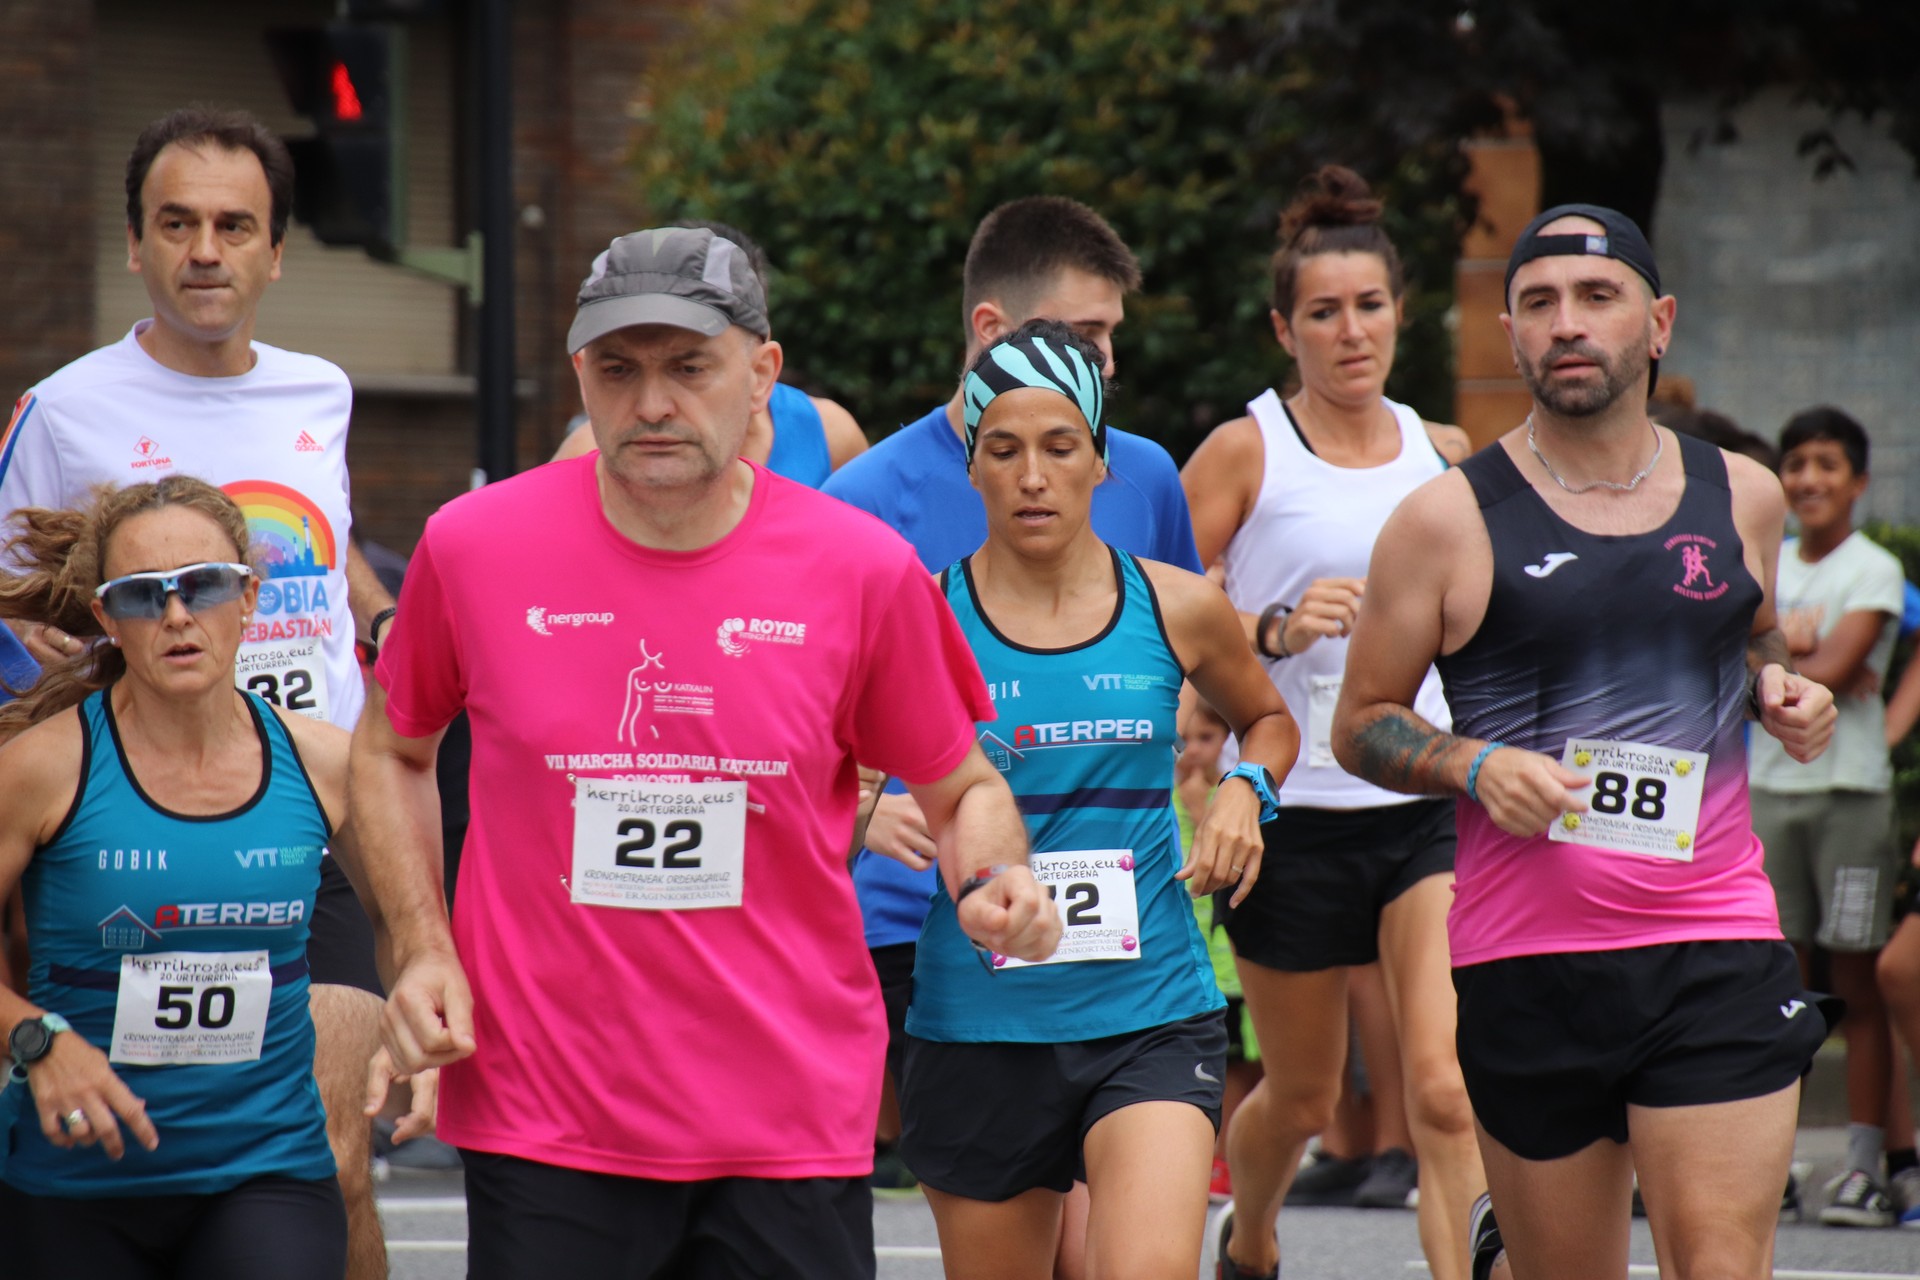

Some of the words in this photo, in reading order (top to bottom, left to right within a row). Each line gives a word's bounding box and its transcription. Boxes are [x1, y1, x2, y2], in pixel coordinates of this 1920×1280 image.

[131, 457, 172, 468] FORTUNA
[749, 618, 806, 637] ROYDE
[236, 660, 293, 673] .URTEURRENA
[247, 669, 316, 710] 32
[988, 680, 1021, 700] BIK
[1082, 673, 1122, 691] VTT
[1014, 719, 1153, 746] ATERPEA
[545, 754, 565, 770] VII
[568, 753, 634, 769] MARCHA
[637, 754, 716, 771] SOLIDARIA
[720, 758, 788, 776] KATXALIN
[1574, 744, 1696, 771] hrrikrosa.es
[587, 783, 735, 805] herrikrosa.eus
[1592, 771, 1667, 821] 88
[617, 803, 706, 815] 20.URTEURRENA
[615, 817, 704, 869] 22
[1596, 833, 1684, 852] ERAGINKORTASUN
[98, 849, 167, 870] GOBIK
[234, 847, 278, 868] VTT
[1033, 859, 1121, 873] ikrosa.eus
[1036, 870, 1099, 882] .URTEURRENA
[155, 899, 304, 928] ATERPEA
[1056, 945, 1125, 955] GINKORTASUN
[132, 956, 261, 973] herrikrosa.eus
[154, 985, 236, 1030] 50
